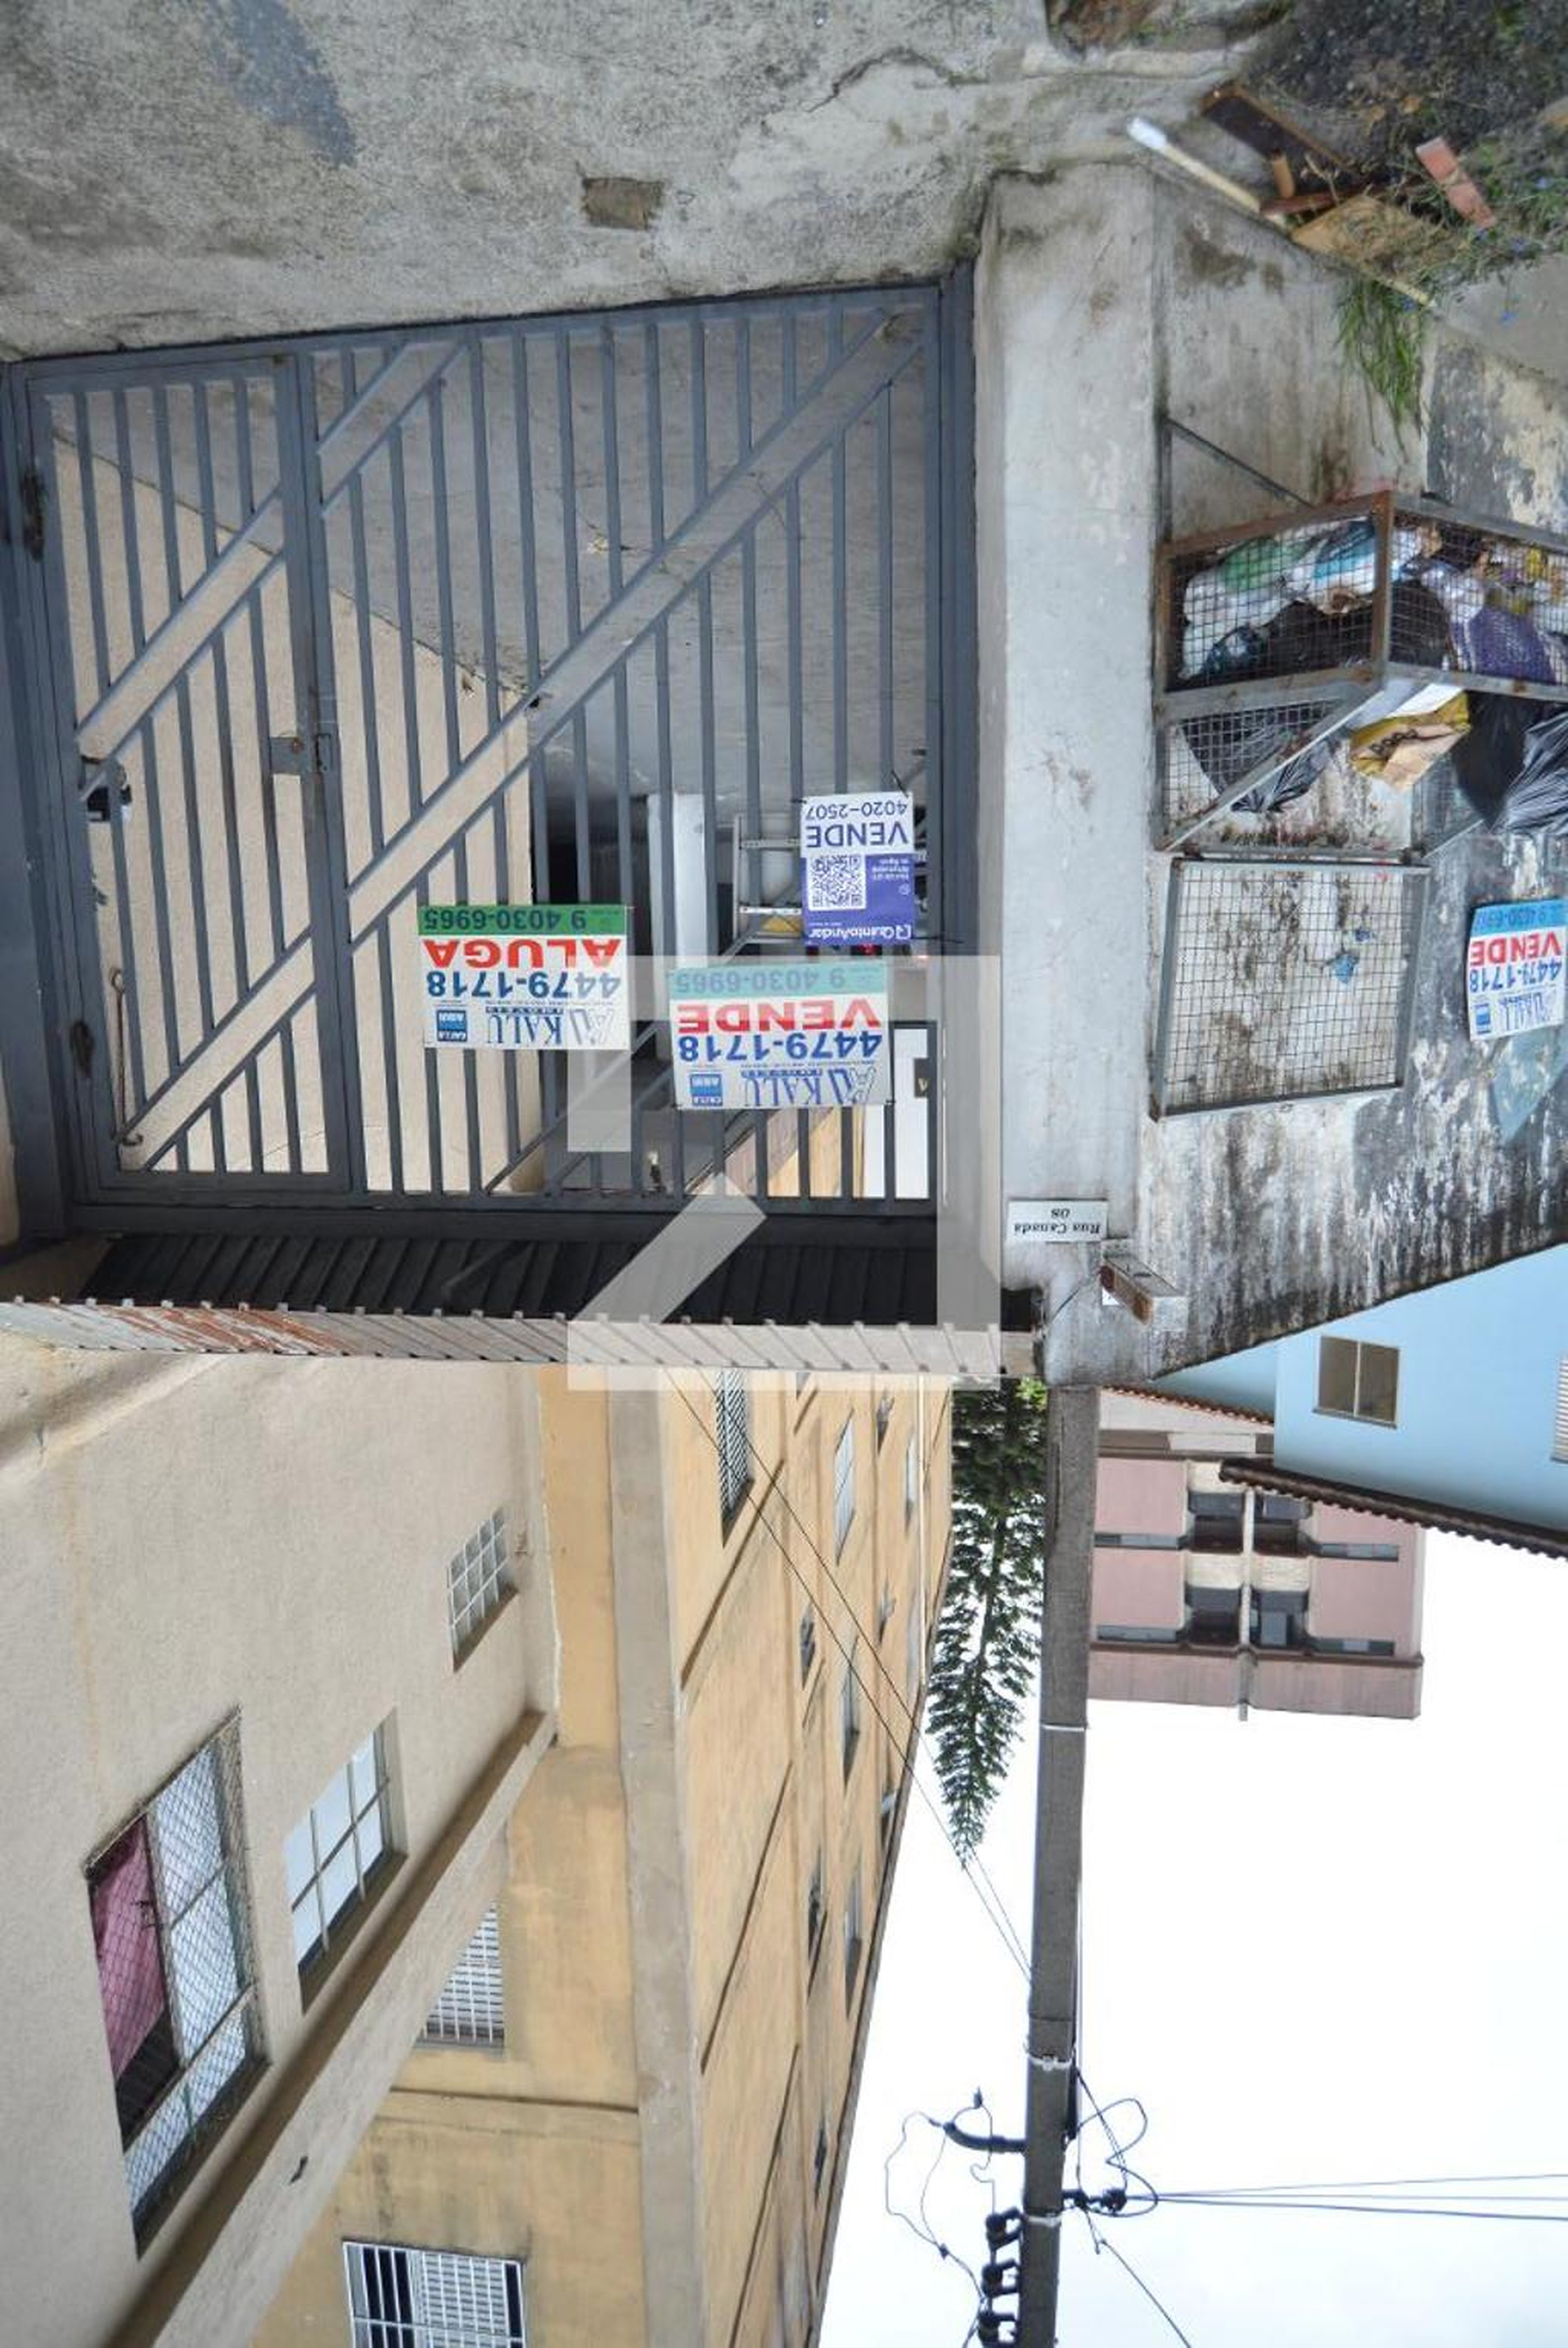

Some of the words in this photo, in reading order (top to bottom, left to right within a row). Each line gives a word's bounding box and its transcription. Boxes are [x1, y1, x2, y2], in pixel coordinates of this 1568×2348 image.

[806, 800, 907, 820] 4020-2507
[806, 821, 908, 847] VENDE
[424, 909, 560, 930] 4030-6965
[571, 909, 586, 930] 9
[808, 926, 894, 939] QuintoAndar
[423, 939, 621, 968] ALUGA
[1470, 931, 1561, 966] VENDE
[426, 971, 621, 999] 4479-1718
[677, 970, 819, 992] 4030-6965
[830, 968, 845, 989] 9
[677, 999, 881, 1034] VENDE
[486, 1015, 562, 1045] KALU
[678, 1031, 882, 1062] 4479-1718
[743, 1077, 821, 1107] KALU
[1073, 1224, 1100, 1234] Rua
